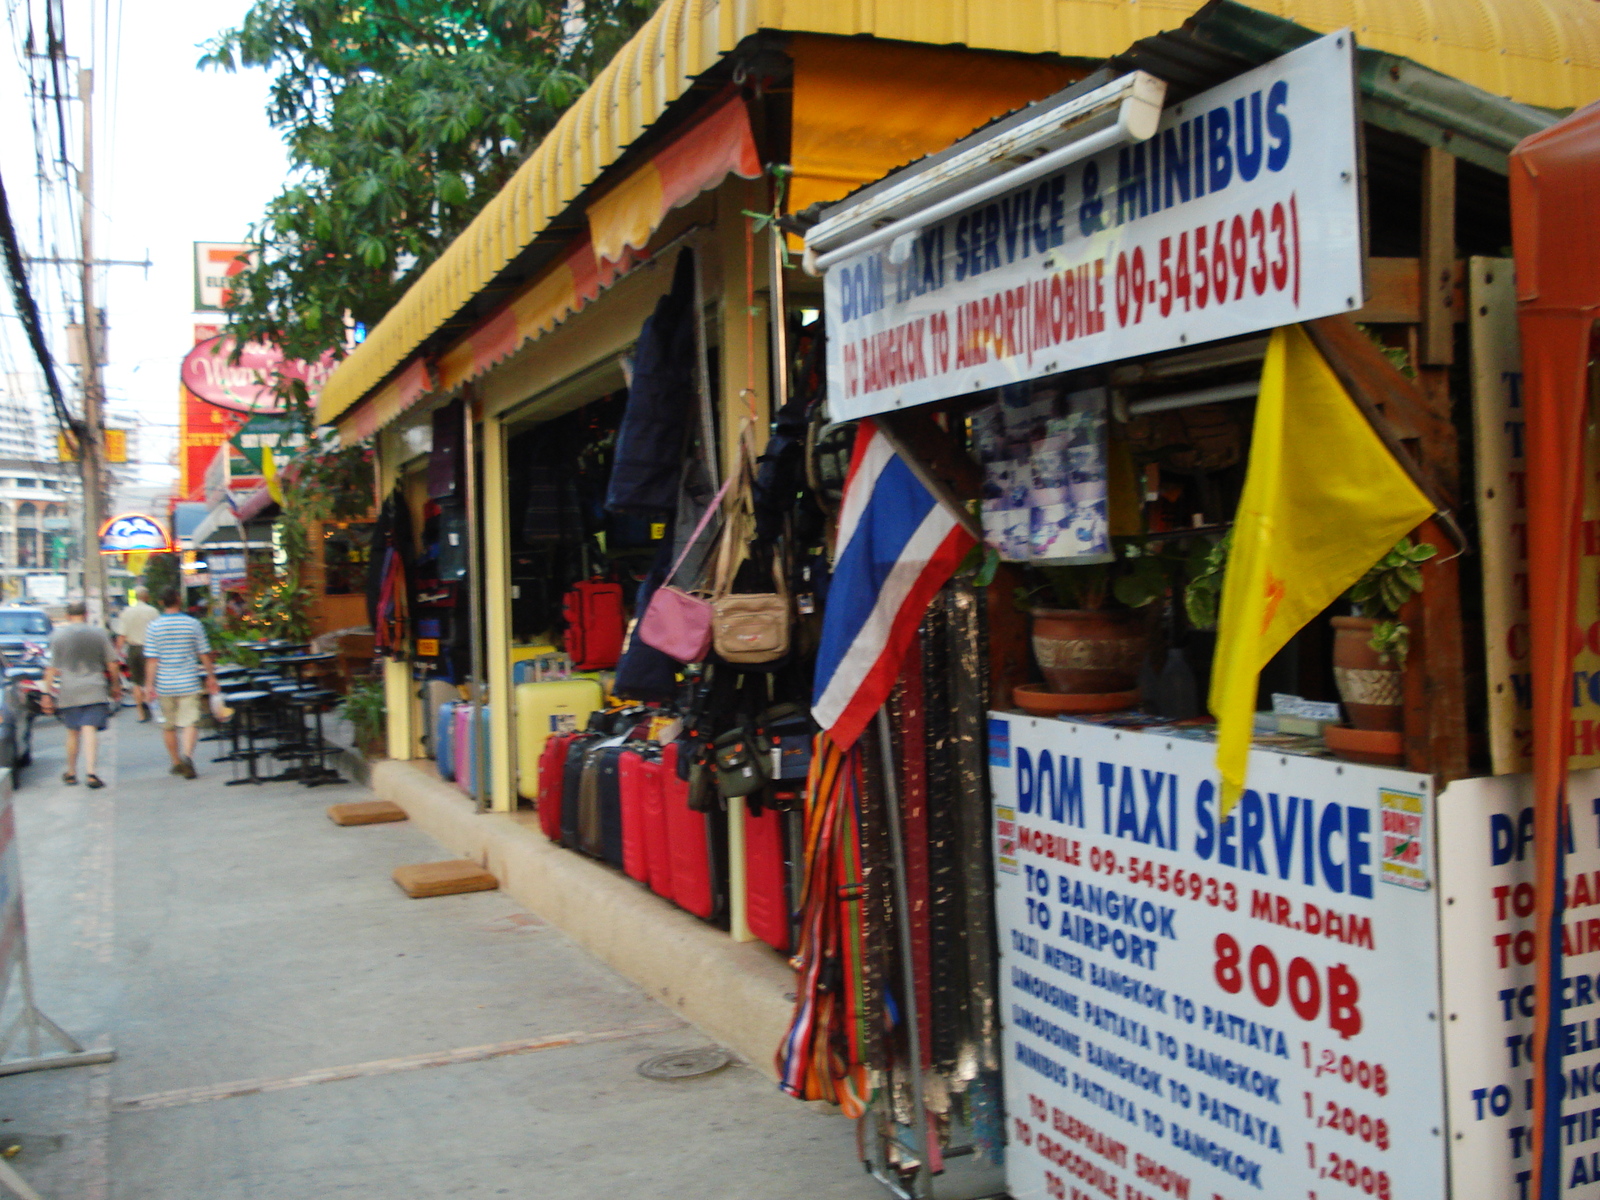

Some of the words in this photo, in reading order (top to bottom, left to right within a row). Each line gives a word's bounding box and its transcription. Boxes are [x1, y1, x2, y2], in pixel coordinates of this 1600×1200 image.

[954, 174, 1066, 282] SERVICE
[1078, 161, 1105, 237] &
[1115, 80, 1291, 226] MINIBUS
[862, 318, 927, 395] BANGKOK
[930, 310, 949, 377] TO
[1016, 746, 1085, 829] DAM
[1097, 761, 1178, 852] TAXI
[1194, 778, 1375, 900] SERVICE
[1017, 825, 1081, 867] MOBILE
[1089, 846, 1238, 912] 09-5456933
[1024, 864, 1049, 897] TO
[1058, 875, 1177, 940] BANGKOK
[1492, 882, 1536, 921] TO
[1025, 897, 1051, 931] TO
[1059, 911, 1158, 971] AIRPORT
[1493, 930, 1537, 969] TO
[1011, 929, 1039, 960] TAXI
[1043, 943, 1085, 981] METER
[1090, 962, 1168, 1014] BANGKOK
[1172, 994, 1196, 1024] TO
[1202, 1005, 1290, 1060] PATTAYA
[1011, 965, 1080, 1018] LIMOUSINE
[1084, 1000, 1152, 1050] PATTAYA
[1156, 1031, 1178, 1061] TO
[1184, 1043, 1281, 1105] BANGKOK
[1012, 1003, 1081, 1058] LIMOUSINE
[1086, 1041, 1164, 1098] BANGKOK
[1168, 1078, 1192, 1109] TO
[1197, 1091, 1284, 1154] PATTAYA
[1015, 1040, 1069, 1088] MINIBUS
[1072, 1072, 1138, 1126] PATTAYA
[1142, 1108, 1165, 1138] TO
[1170, 1122, 1264, 1190] BANGKOK
[1471, 1083, 1512, 1121] TO
[1014, 1117, 1032, 1146] TO
[1036, 1132, 1119, 1200] CROCODILE
[1028, 1092, 1048, 1123] TO
[1052, 1105, 1129, 1169] ELEPHANT
[1134, 1153, 1191, 1200] SHOW
[1044, 1170, 1066, 1200] TO
